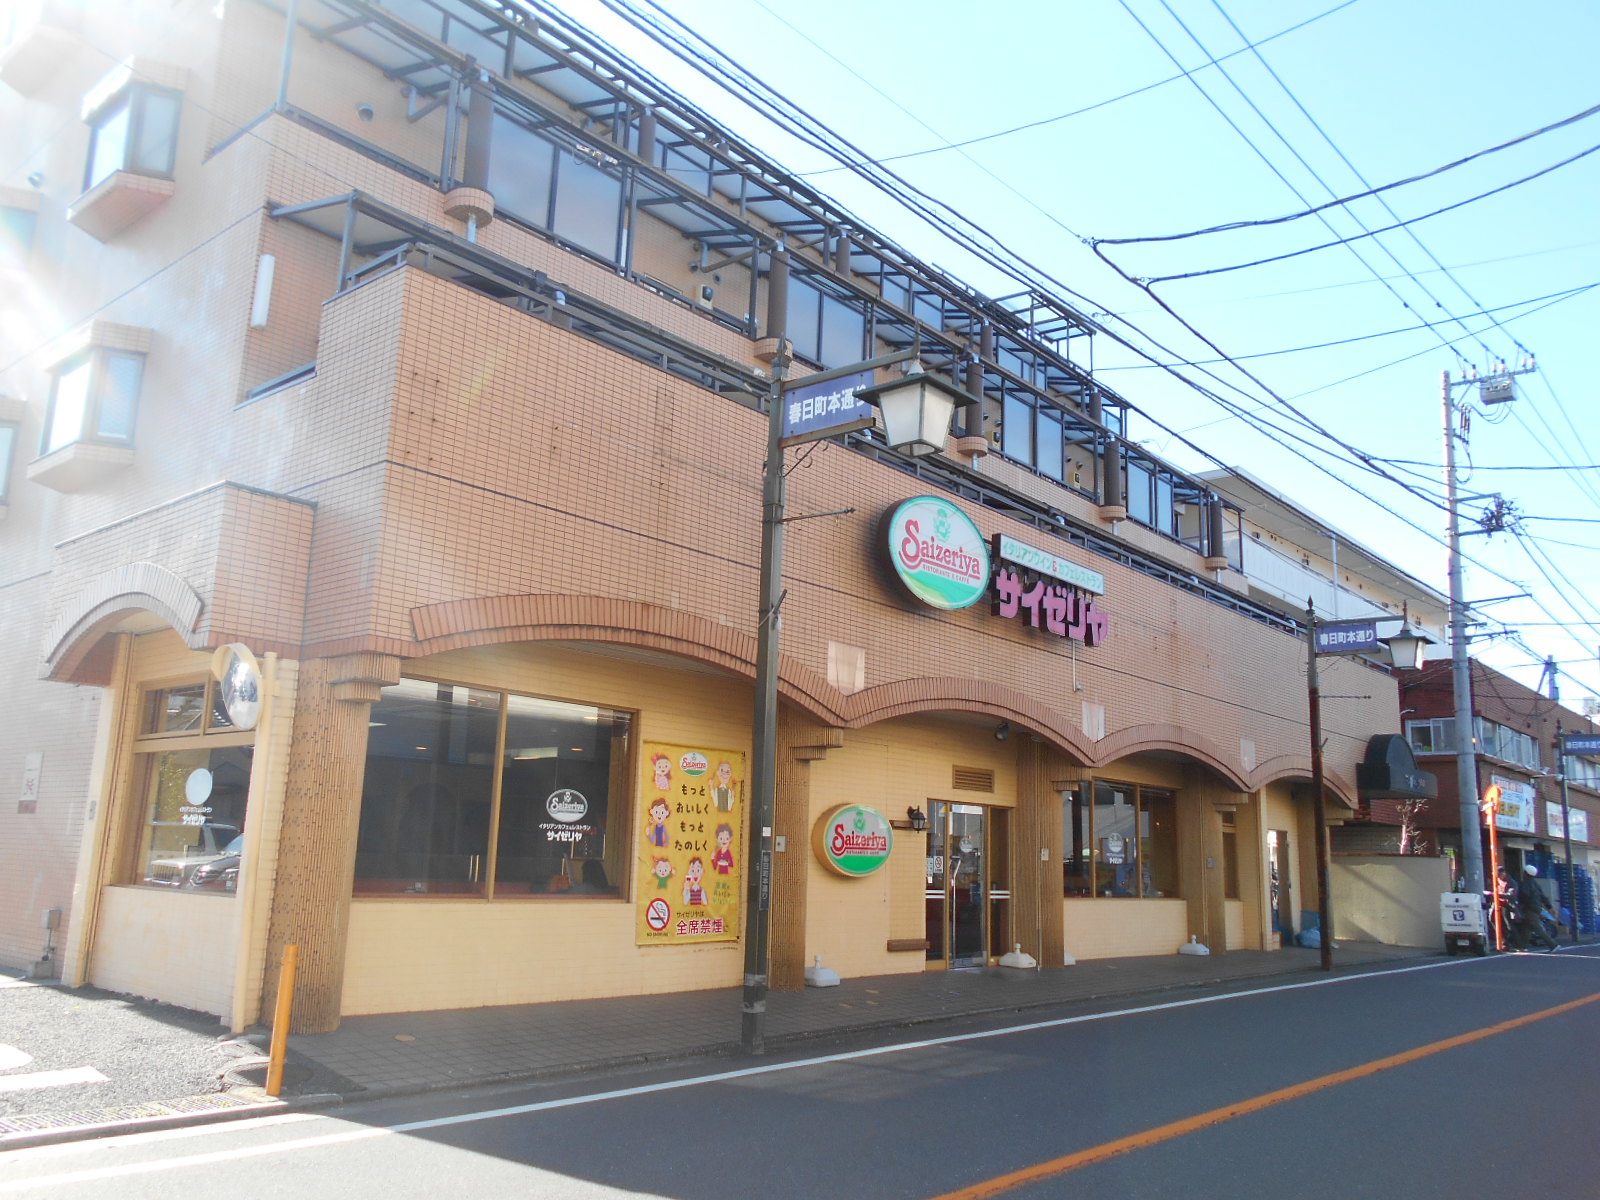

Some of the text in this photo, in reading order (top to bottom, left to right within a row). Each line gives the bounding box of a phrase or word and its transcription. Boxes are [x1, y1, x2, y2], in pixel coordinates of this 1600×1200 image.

[900, 519, 981, 579] Saizeriya
[996, 567, 1109, 648] サイゼリヤ
[1320, 629, 1374, 646] 春日町本通り
[681, 784, 706, 796] もっと
[676, 802, 709, 815] おいしく
[680, 821, 704, 833] もっと
[547, 830, 583, 842] サイゼリヤ
[831, 823, 887, 855] Saizeriya
[674, 840, 708, 852] たのしく
